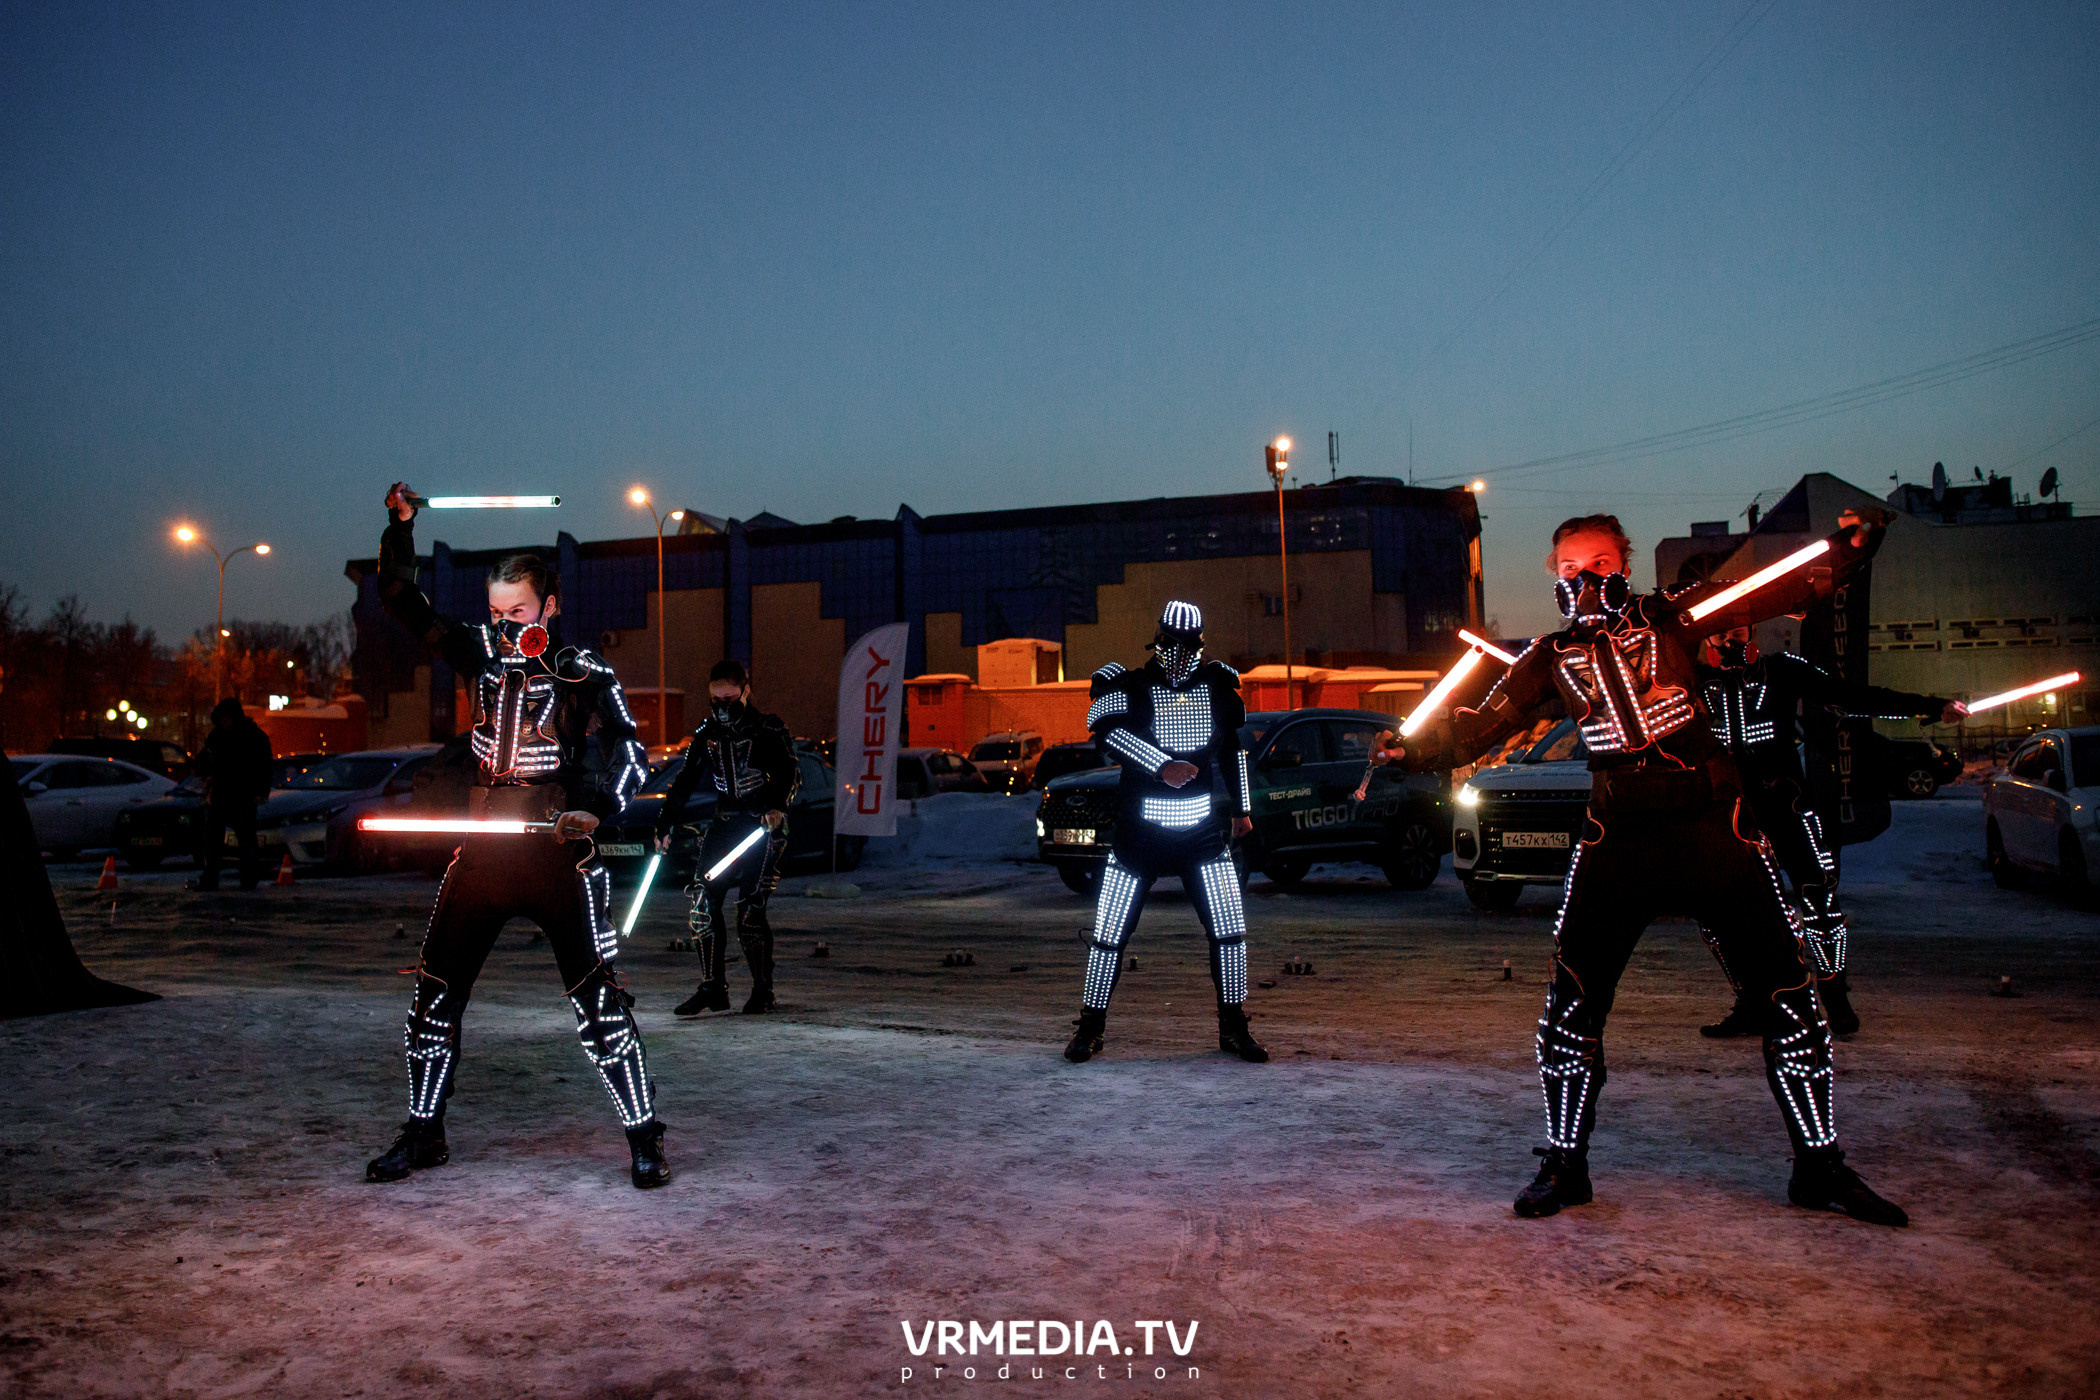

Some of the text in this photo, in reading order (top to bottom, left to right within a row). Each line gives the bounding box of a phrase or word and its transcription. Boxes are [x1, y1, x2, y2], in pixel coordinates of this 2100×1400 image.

[858, 646, 890, 814] CHERY
[1268, 787, 1312, 801] ТЕСТ-ДРАЙВ
[1506, 834, 1567, 847] Т457КХ 142
